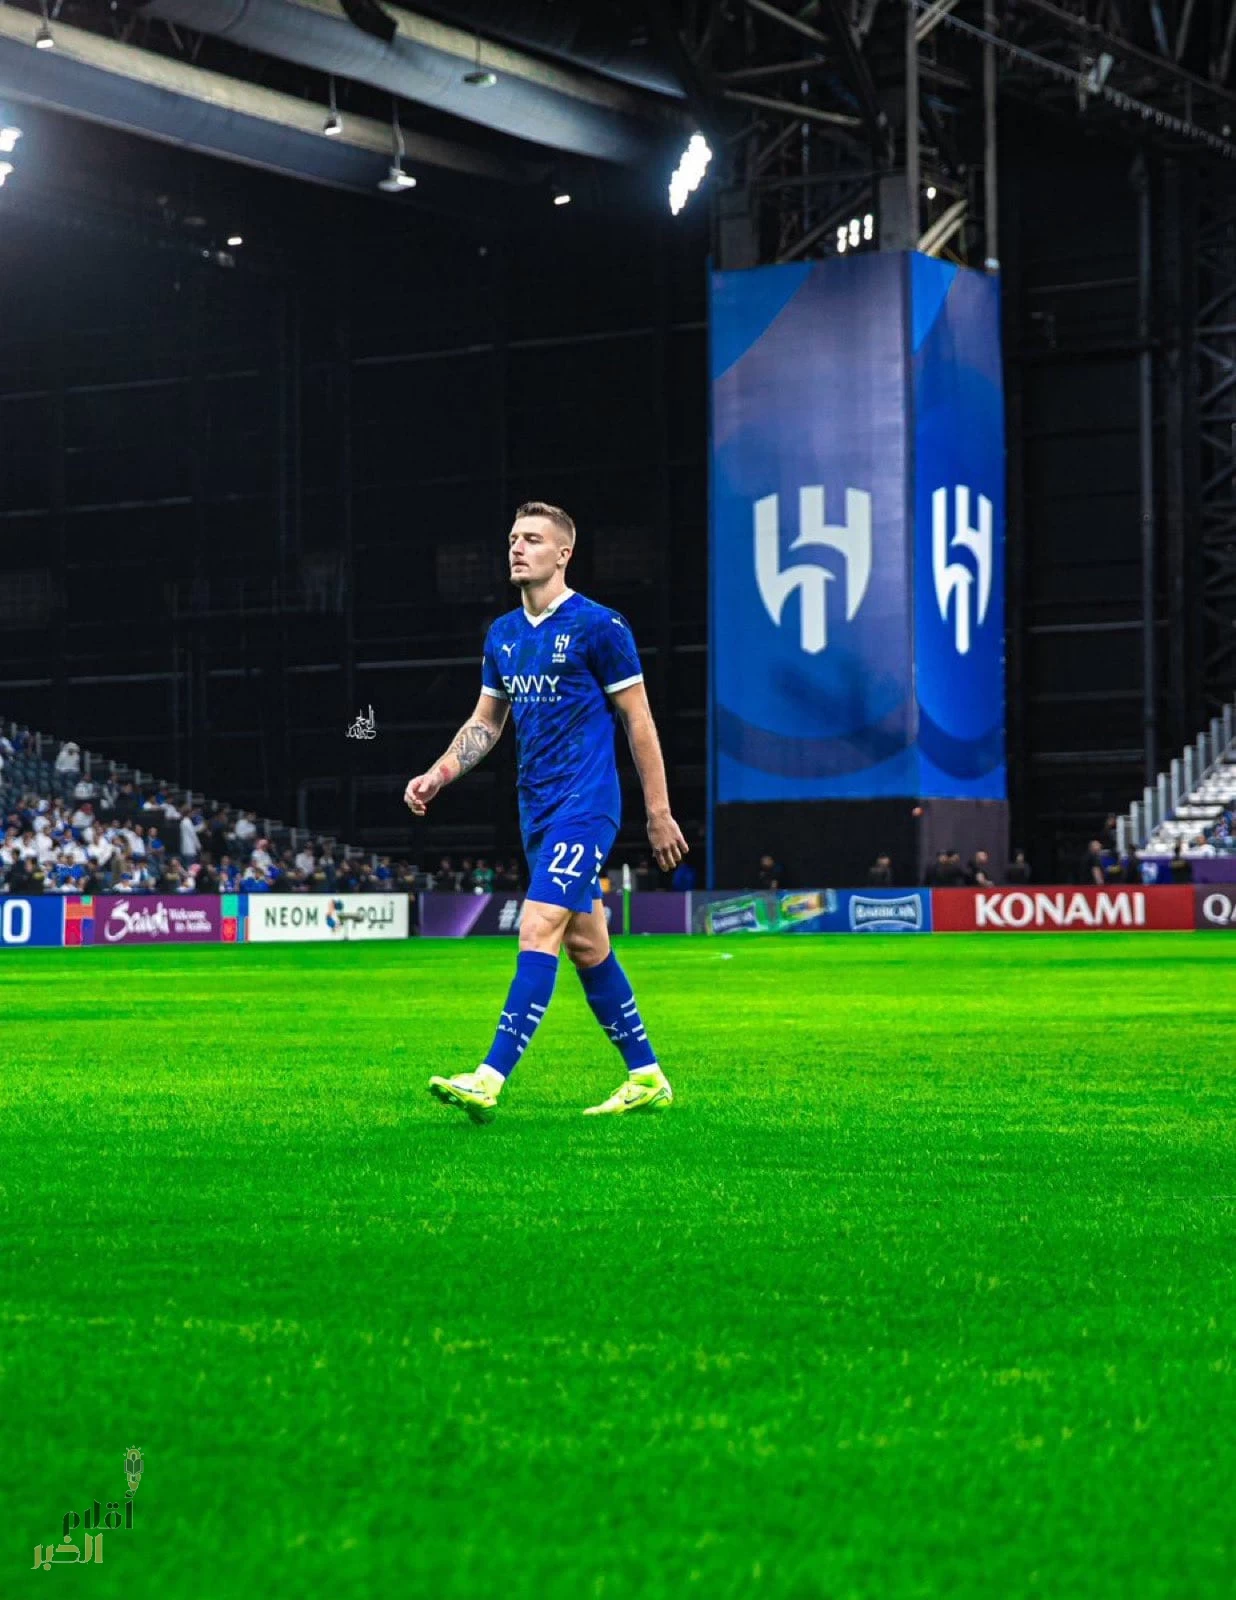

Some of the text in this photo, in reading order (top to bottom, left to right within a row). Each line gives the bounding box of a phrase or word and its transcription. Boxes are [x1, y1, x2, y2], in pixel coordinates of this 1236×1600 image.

[502, 674, 560, 694] SAVVY
[547, 842, 585, 878] 22
[264, 906, 319, 927] NEOM
[974, 891, 1146, 927] KONAMI
[1202, 893, 1236, 925] Q
